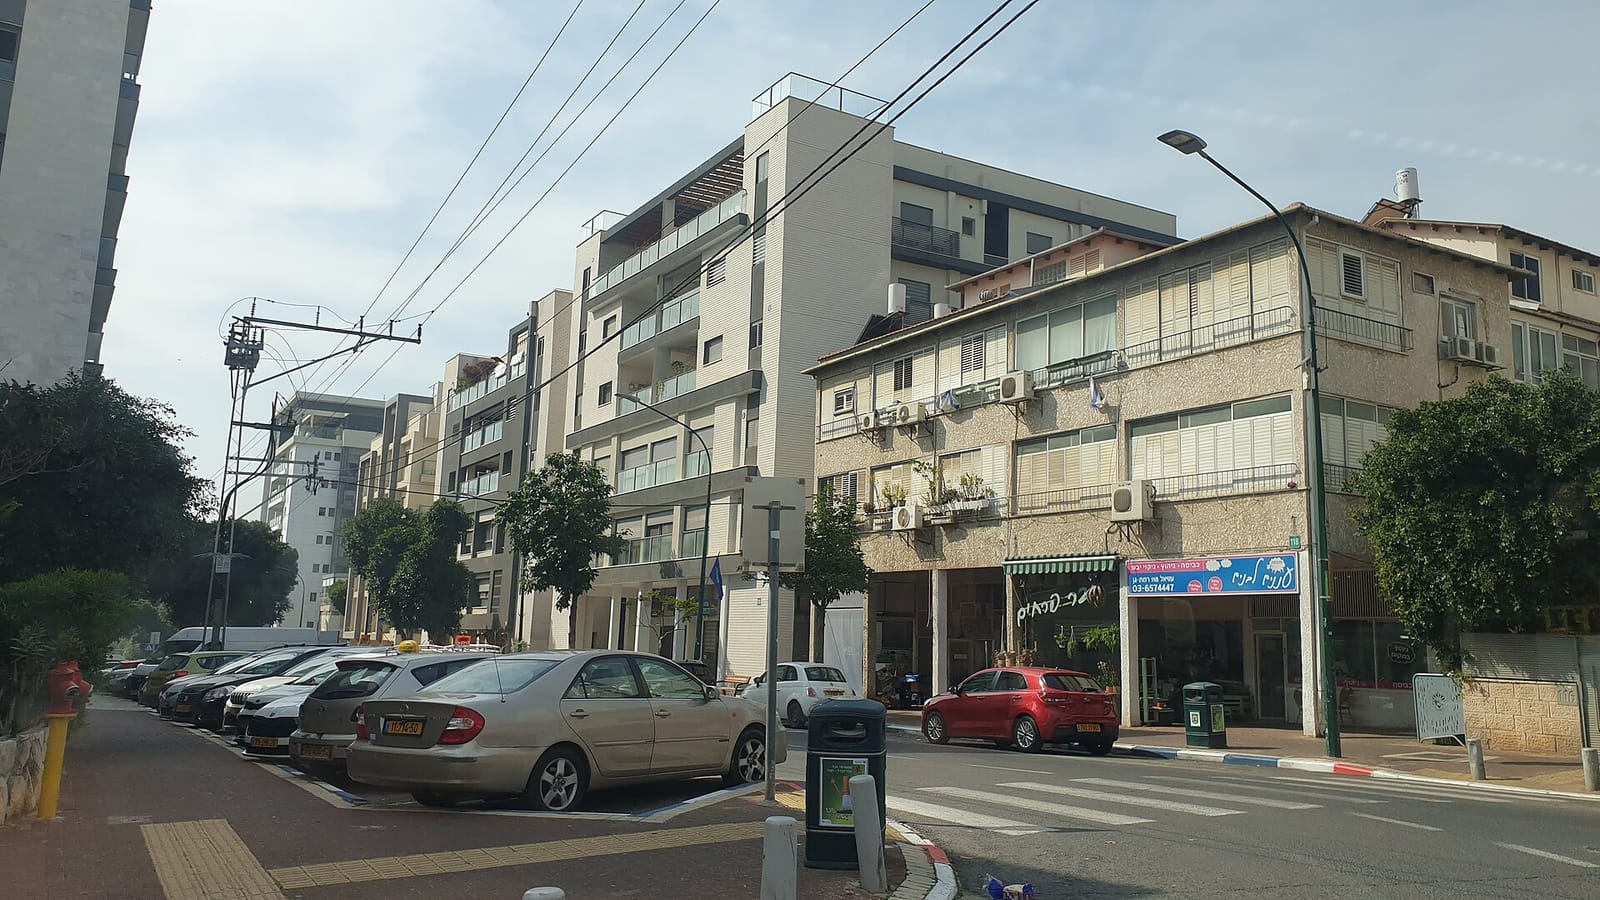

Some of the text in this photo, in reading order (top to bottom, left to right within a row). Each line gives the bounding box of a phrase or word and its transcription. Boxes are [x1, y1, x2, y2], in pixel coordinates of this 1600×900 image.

[1232, 558, 1264, 586] לבנים
[1262, 567, 1294, 590] עננים
[1132, 584, 1174, 593] 03-6574447
